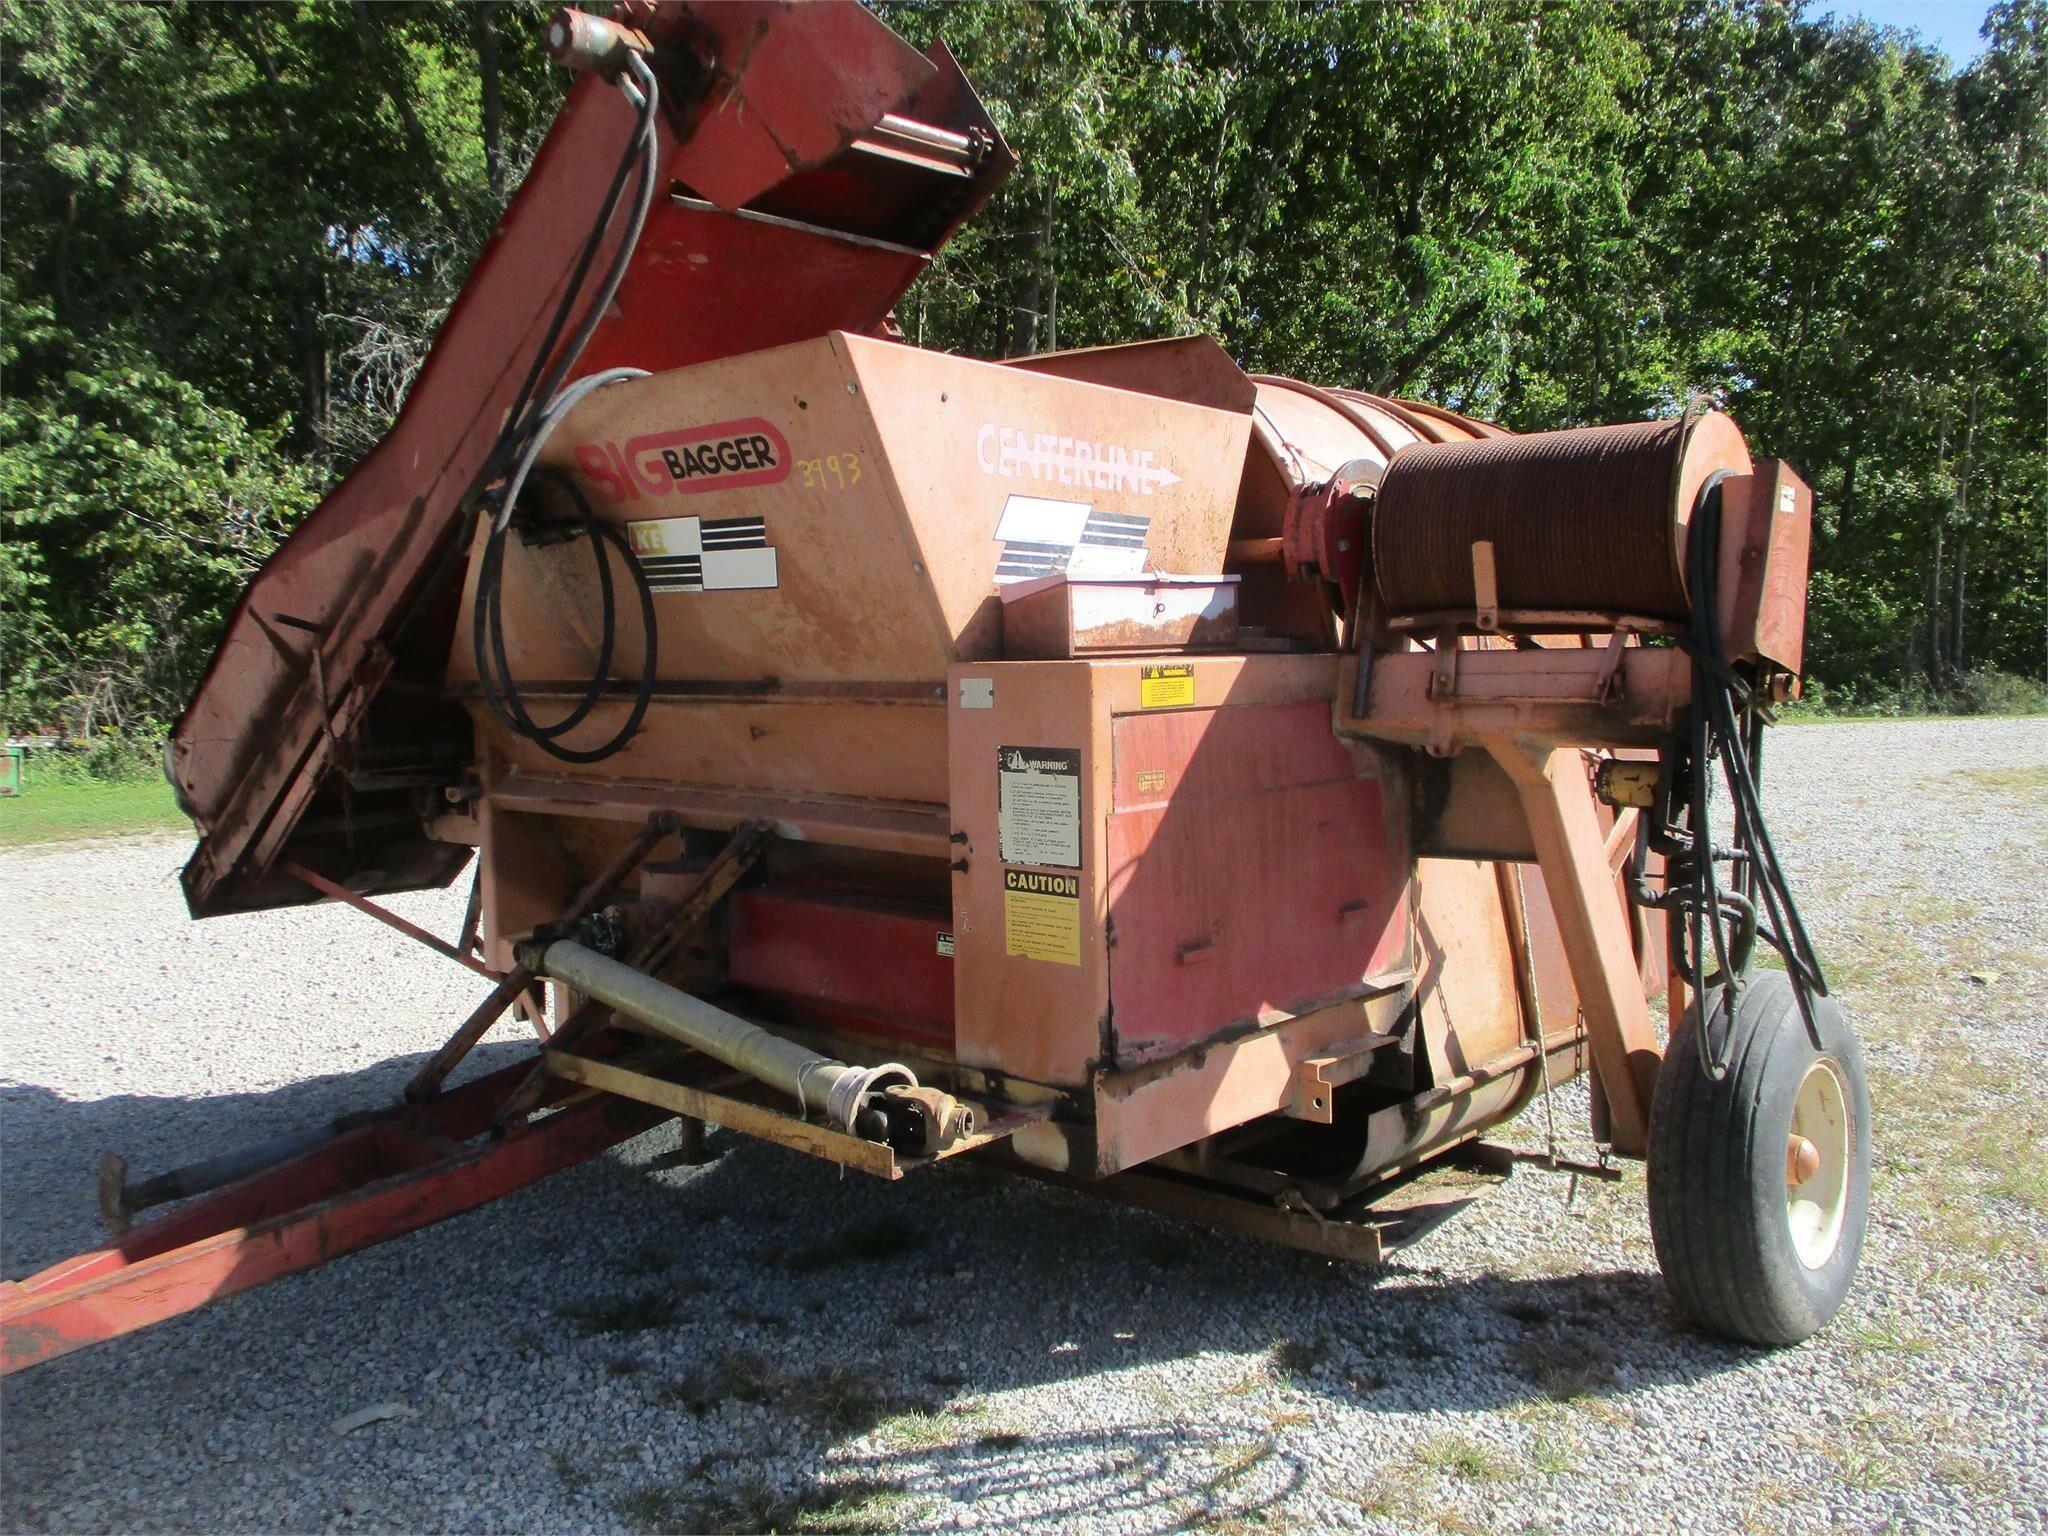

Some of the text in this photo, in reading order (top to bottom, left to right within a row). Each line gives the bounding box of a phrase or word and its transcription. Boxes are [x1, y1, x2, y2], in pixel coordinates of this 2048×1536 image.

[574, 435, 777, 503] BIG BAGGER
[976, 423, 1154, 496] CENTERLINE
[1027, 760, 1069, 771] WARNING
[1007, 872, 1077, 895] CAUTION
